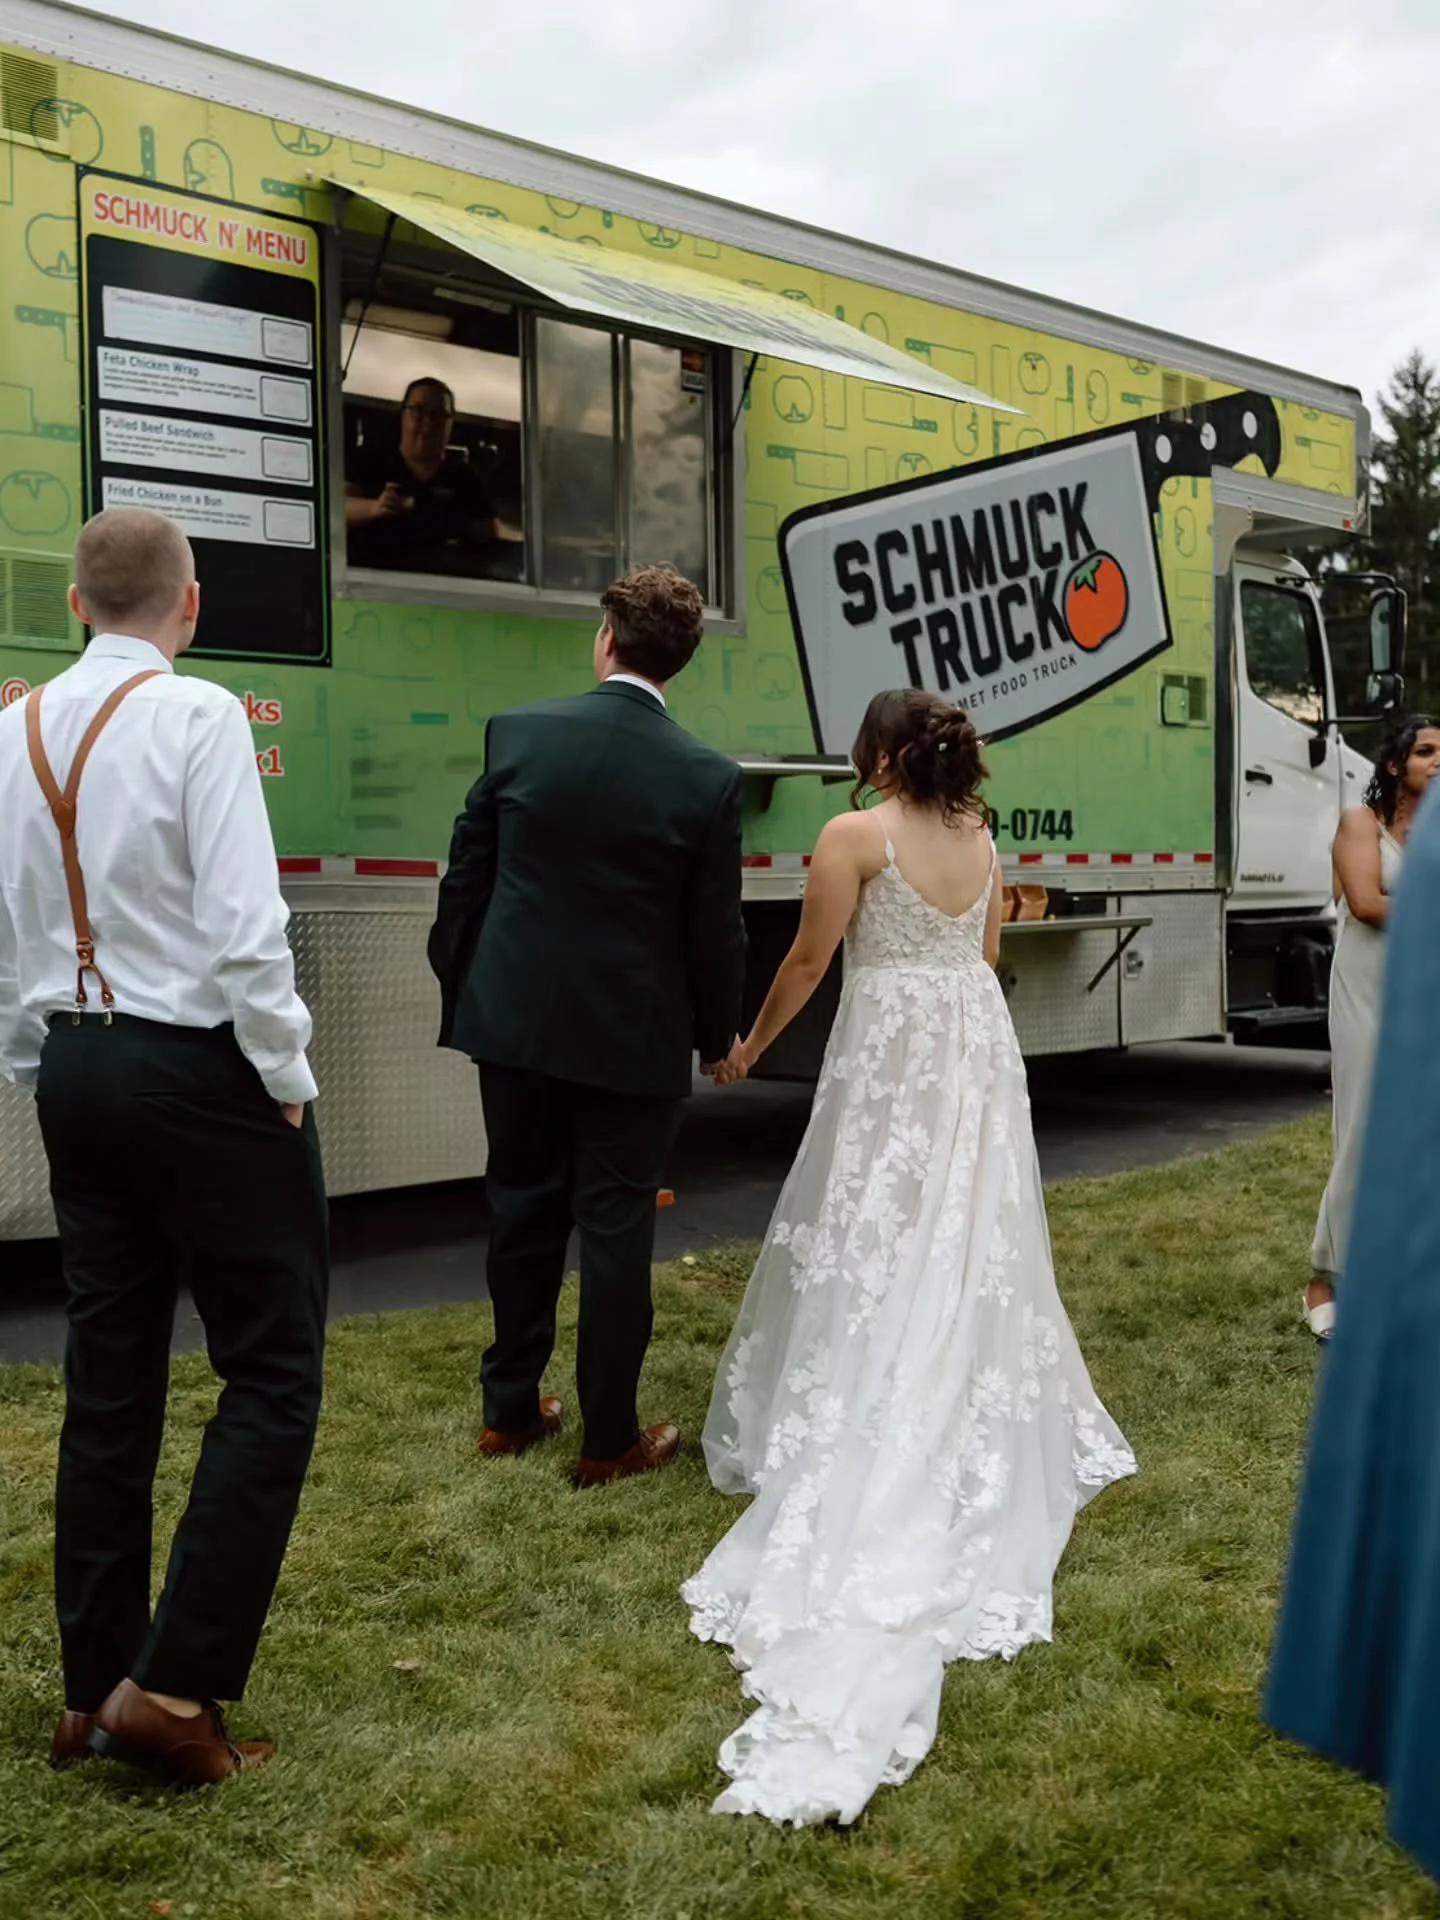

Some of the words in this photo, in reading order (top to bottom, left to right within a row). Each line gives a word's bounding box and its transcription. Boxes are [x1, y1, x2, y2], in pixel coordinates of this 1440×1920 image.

[94, 193, 208, 243] SCHMUCK
[218, 220, 239, 249] N'
[246, 229, 307, 265] MENU
[103, 351, 126, 366] Feta
[129, 355, 170, 371] Chicken
[173, 362, 200, 377] Wrap
[105, 416, 138, 431] Pulled
[141, 421, 164, 434] Beef
[167, 424, 215, 442] Sandwich
[107, 483, 134, 497] Fried
[137, 487, 177, 502] Chicken
[180, 493, 192, 503] on
[203, 494, 223, 507] Bun
[833, 482, 1097, 627] SCHMUCK
[890, 569, 1070, 692] TRUCK
[951, 690, 986, 711] MET
[991, 673, 1028, 700] FOOD
[1032, 654, 1078, 682] TRUCK
